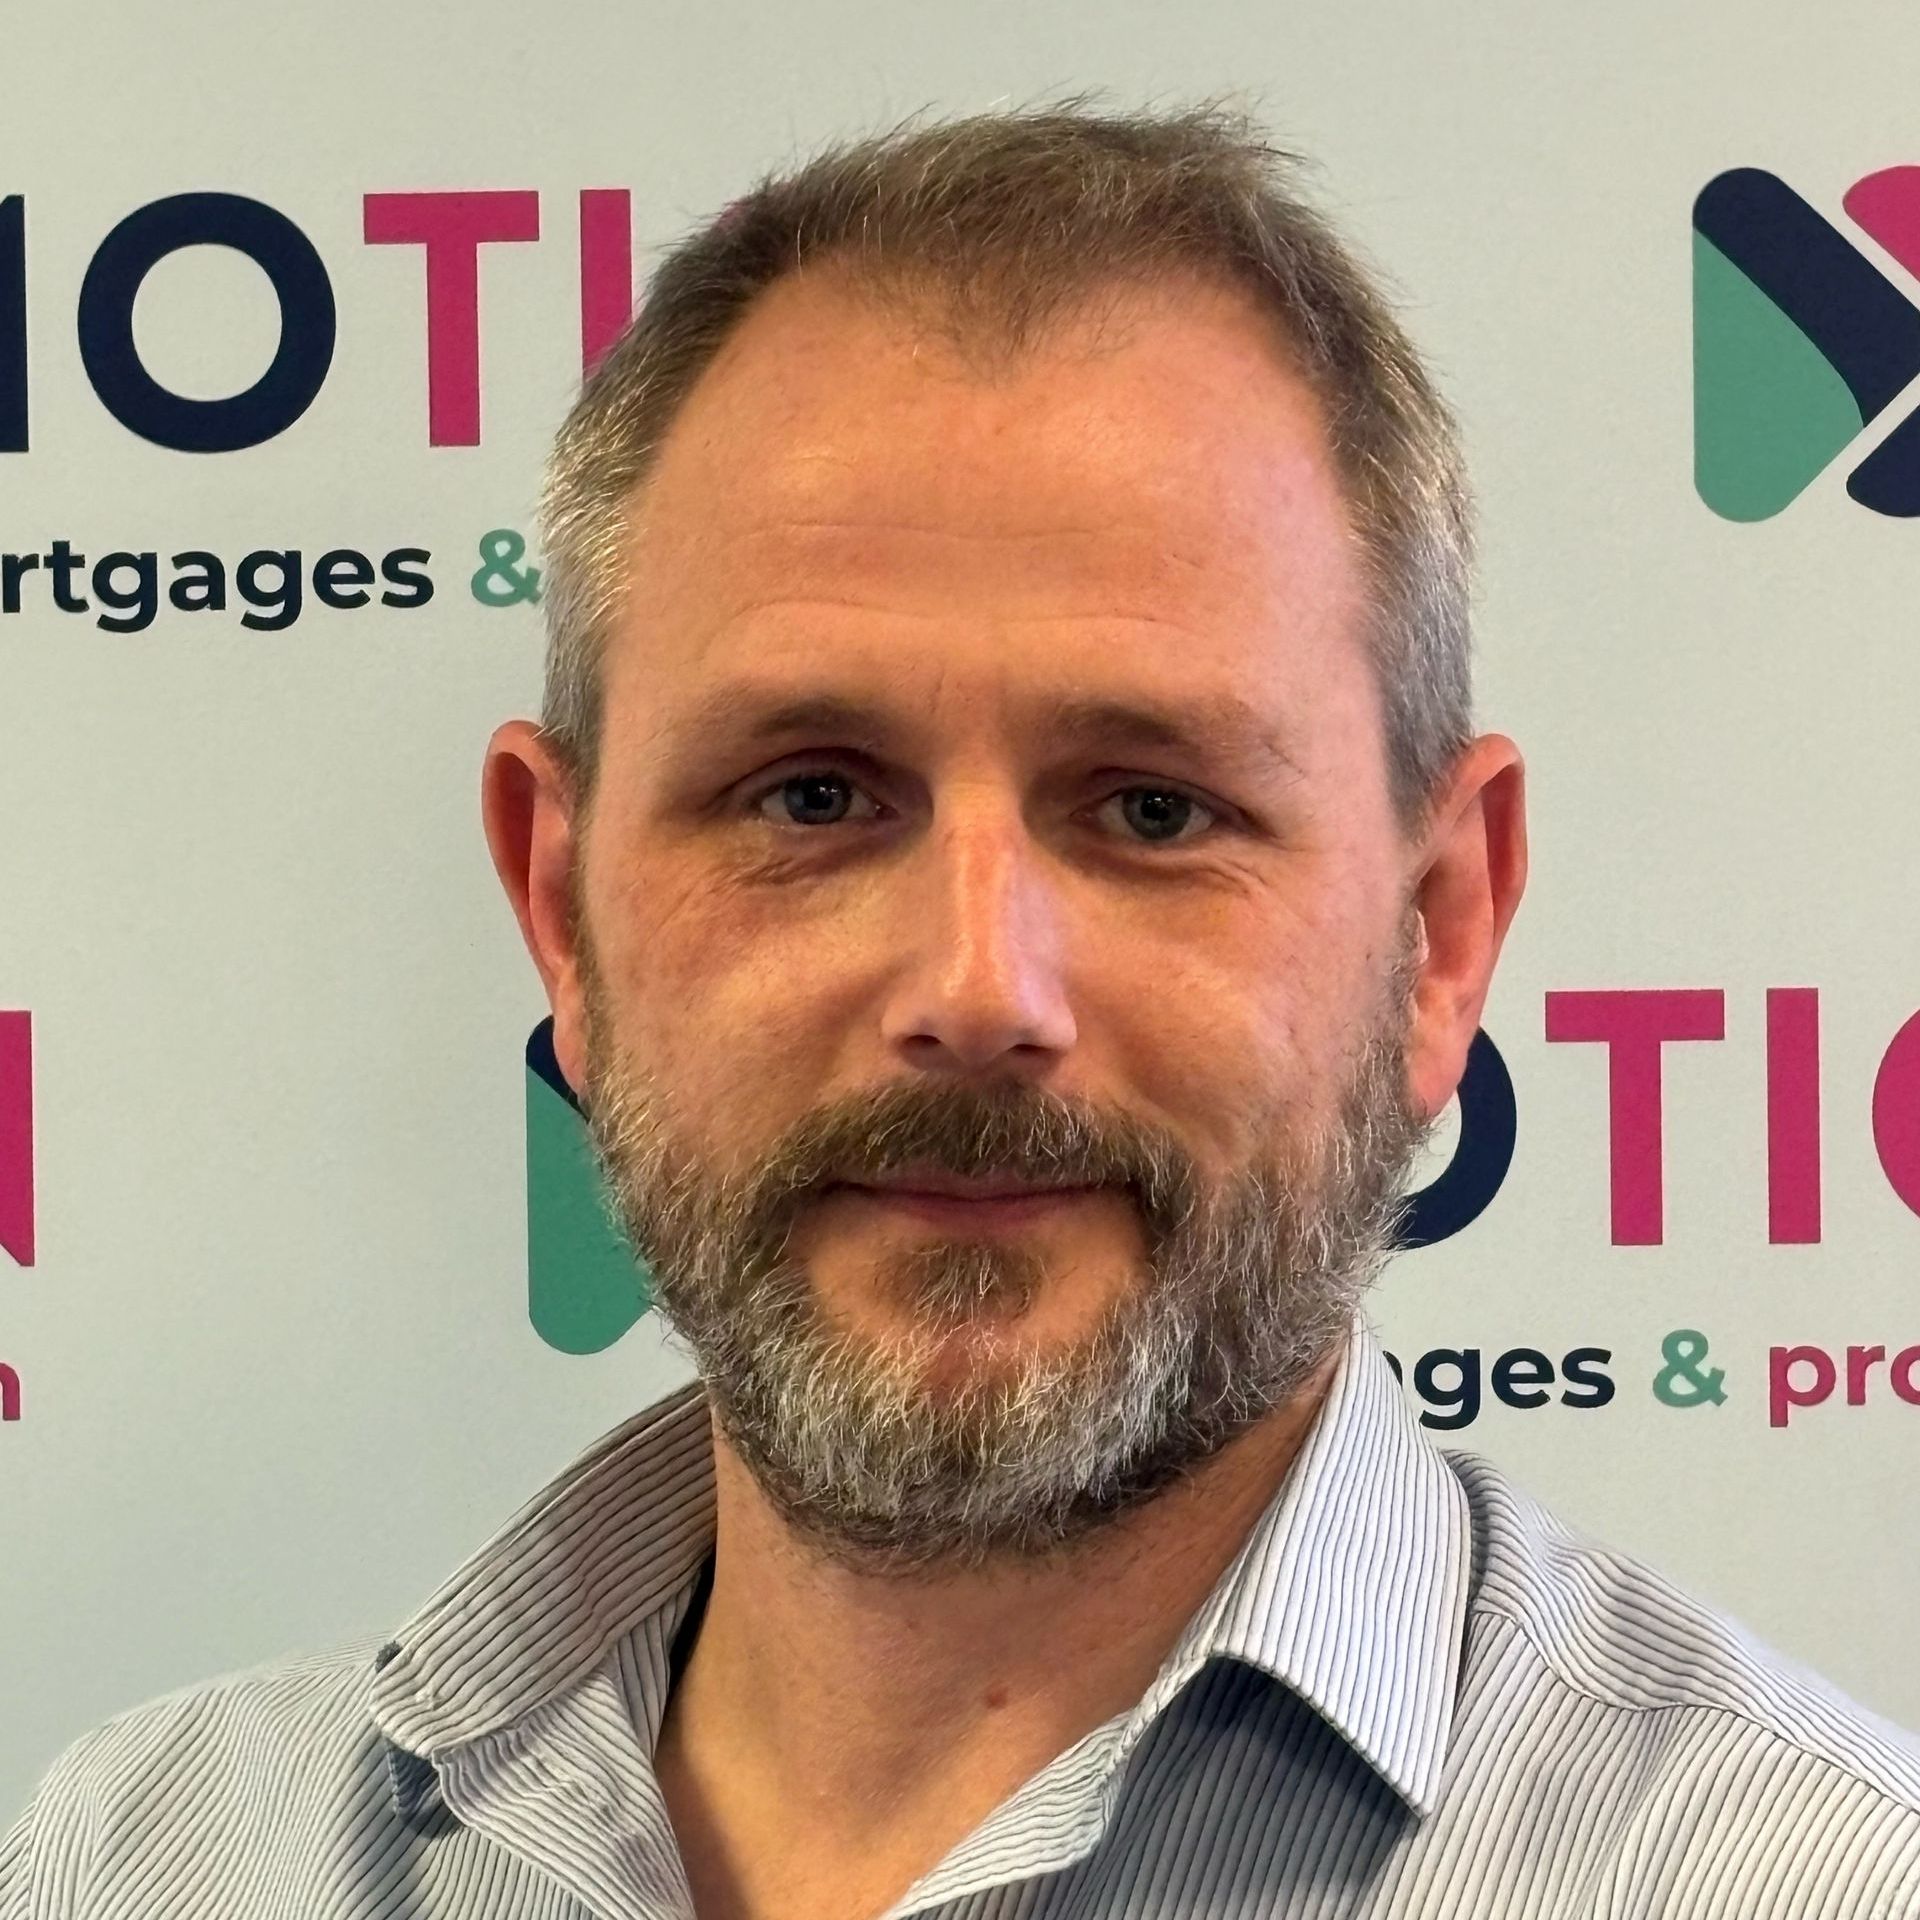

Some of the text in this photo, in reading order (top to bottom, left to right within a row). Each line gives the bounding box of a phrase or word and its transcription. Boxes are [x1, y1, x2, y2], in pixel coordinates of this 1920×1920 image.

[2, 528, 542, 633] rtgages &
[1383, 1347, 1616, 1431] ges
[1652, 1328, 1728, 1408] &
